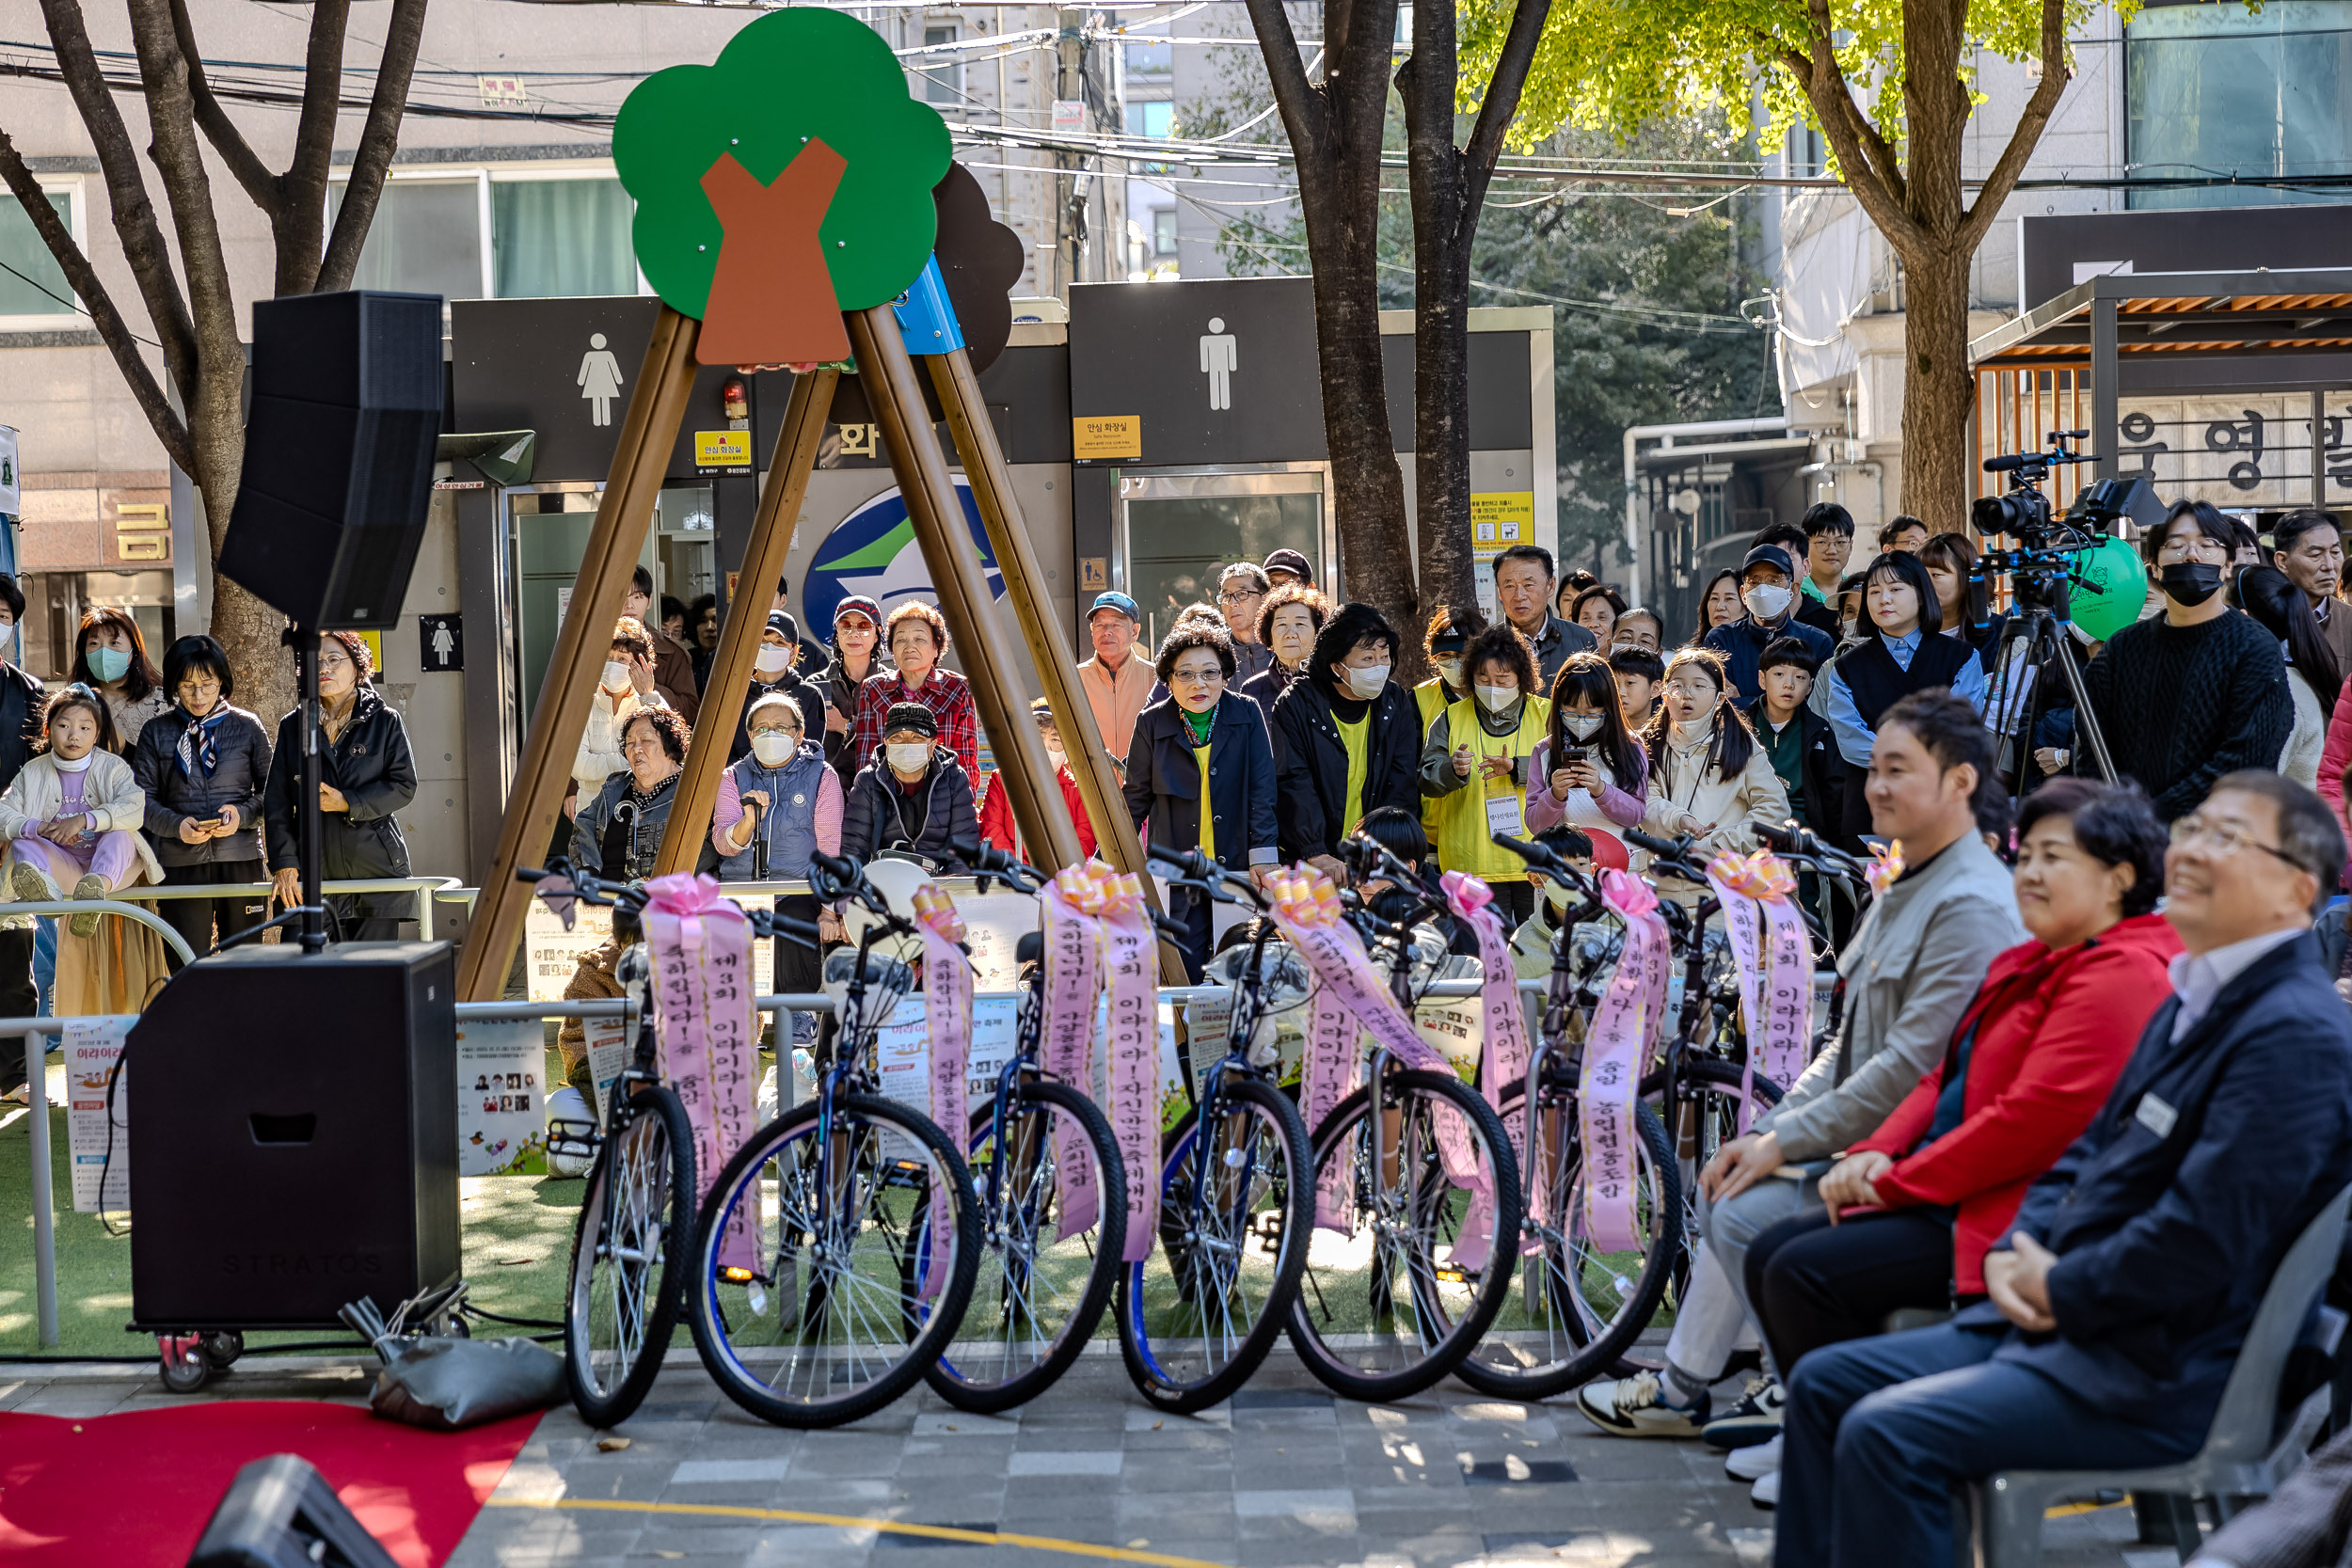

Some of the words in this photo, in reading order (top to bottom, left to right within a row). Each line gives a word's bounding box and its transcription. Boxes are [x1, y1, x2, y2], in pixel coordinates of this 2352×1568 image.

[1087, 422, 1102, 433] 안심
[1104, 422, 1127, 432] 화장실
[223, 1254, 382, 1275] STRATOS
